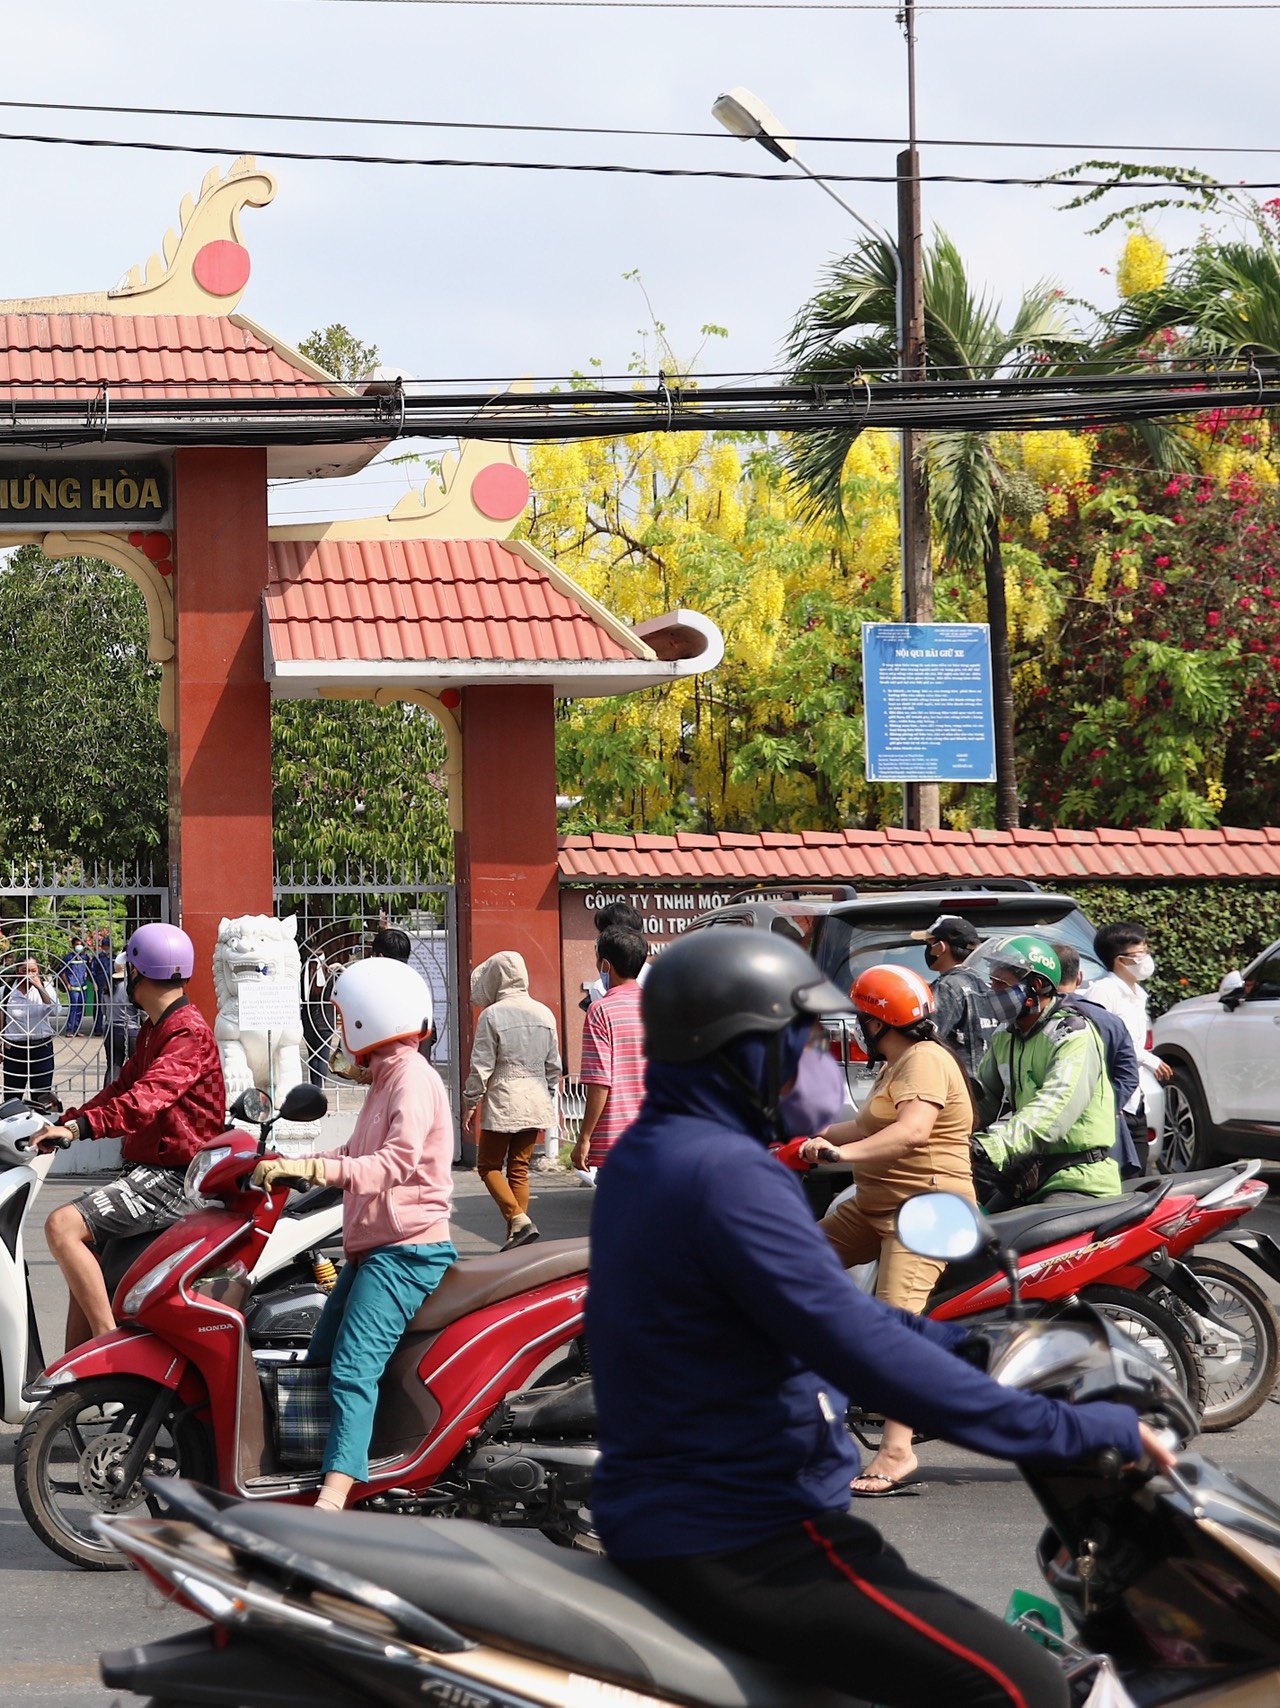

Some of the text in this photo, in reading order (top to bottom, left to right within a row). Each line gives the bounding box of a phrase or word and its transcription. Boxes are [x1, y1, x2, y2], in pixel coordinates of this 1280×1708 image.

[92, 470, 162, 509] HÒA
[629, 894, 650, 910] TY
[654, 894, 694, 910] TNHH
[1028, 949, 1056, 970] Grab
[197, 1323, 234, 1333] HONDA
